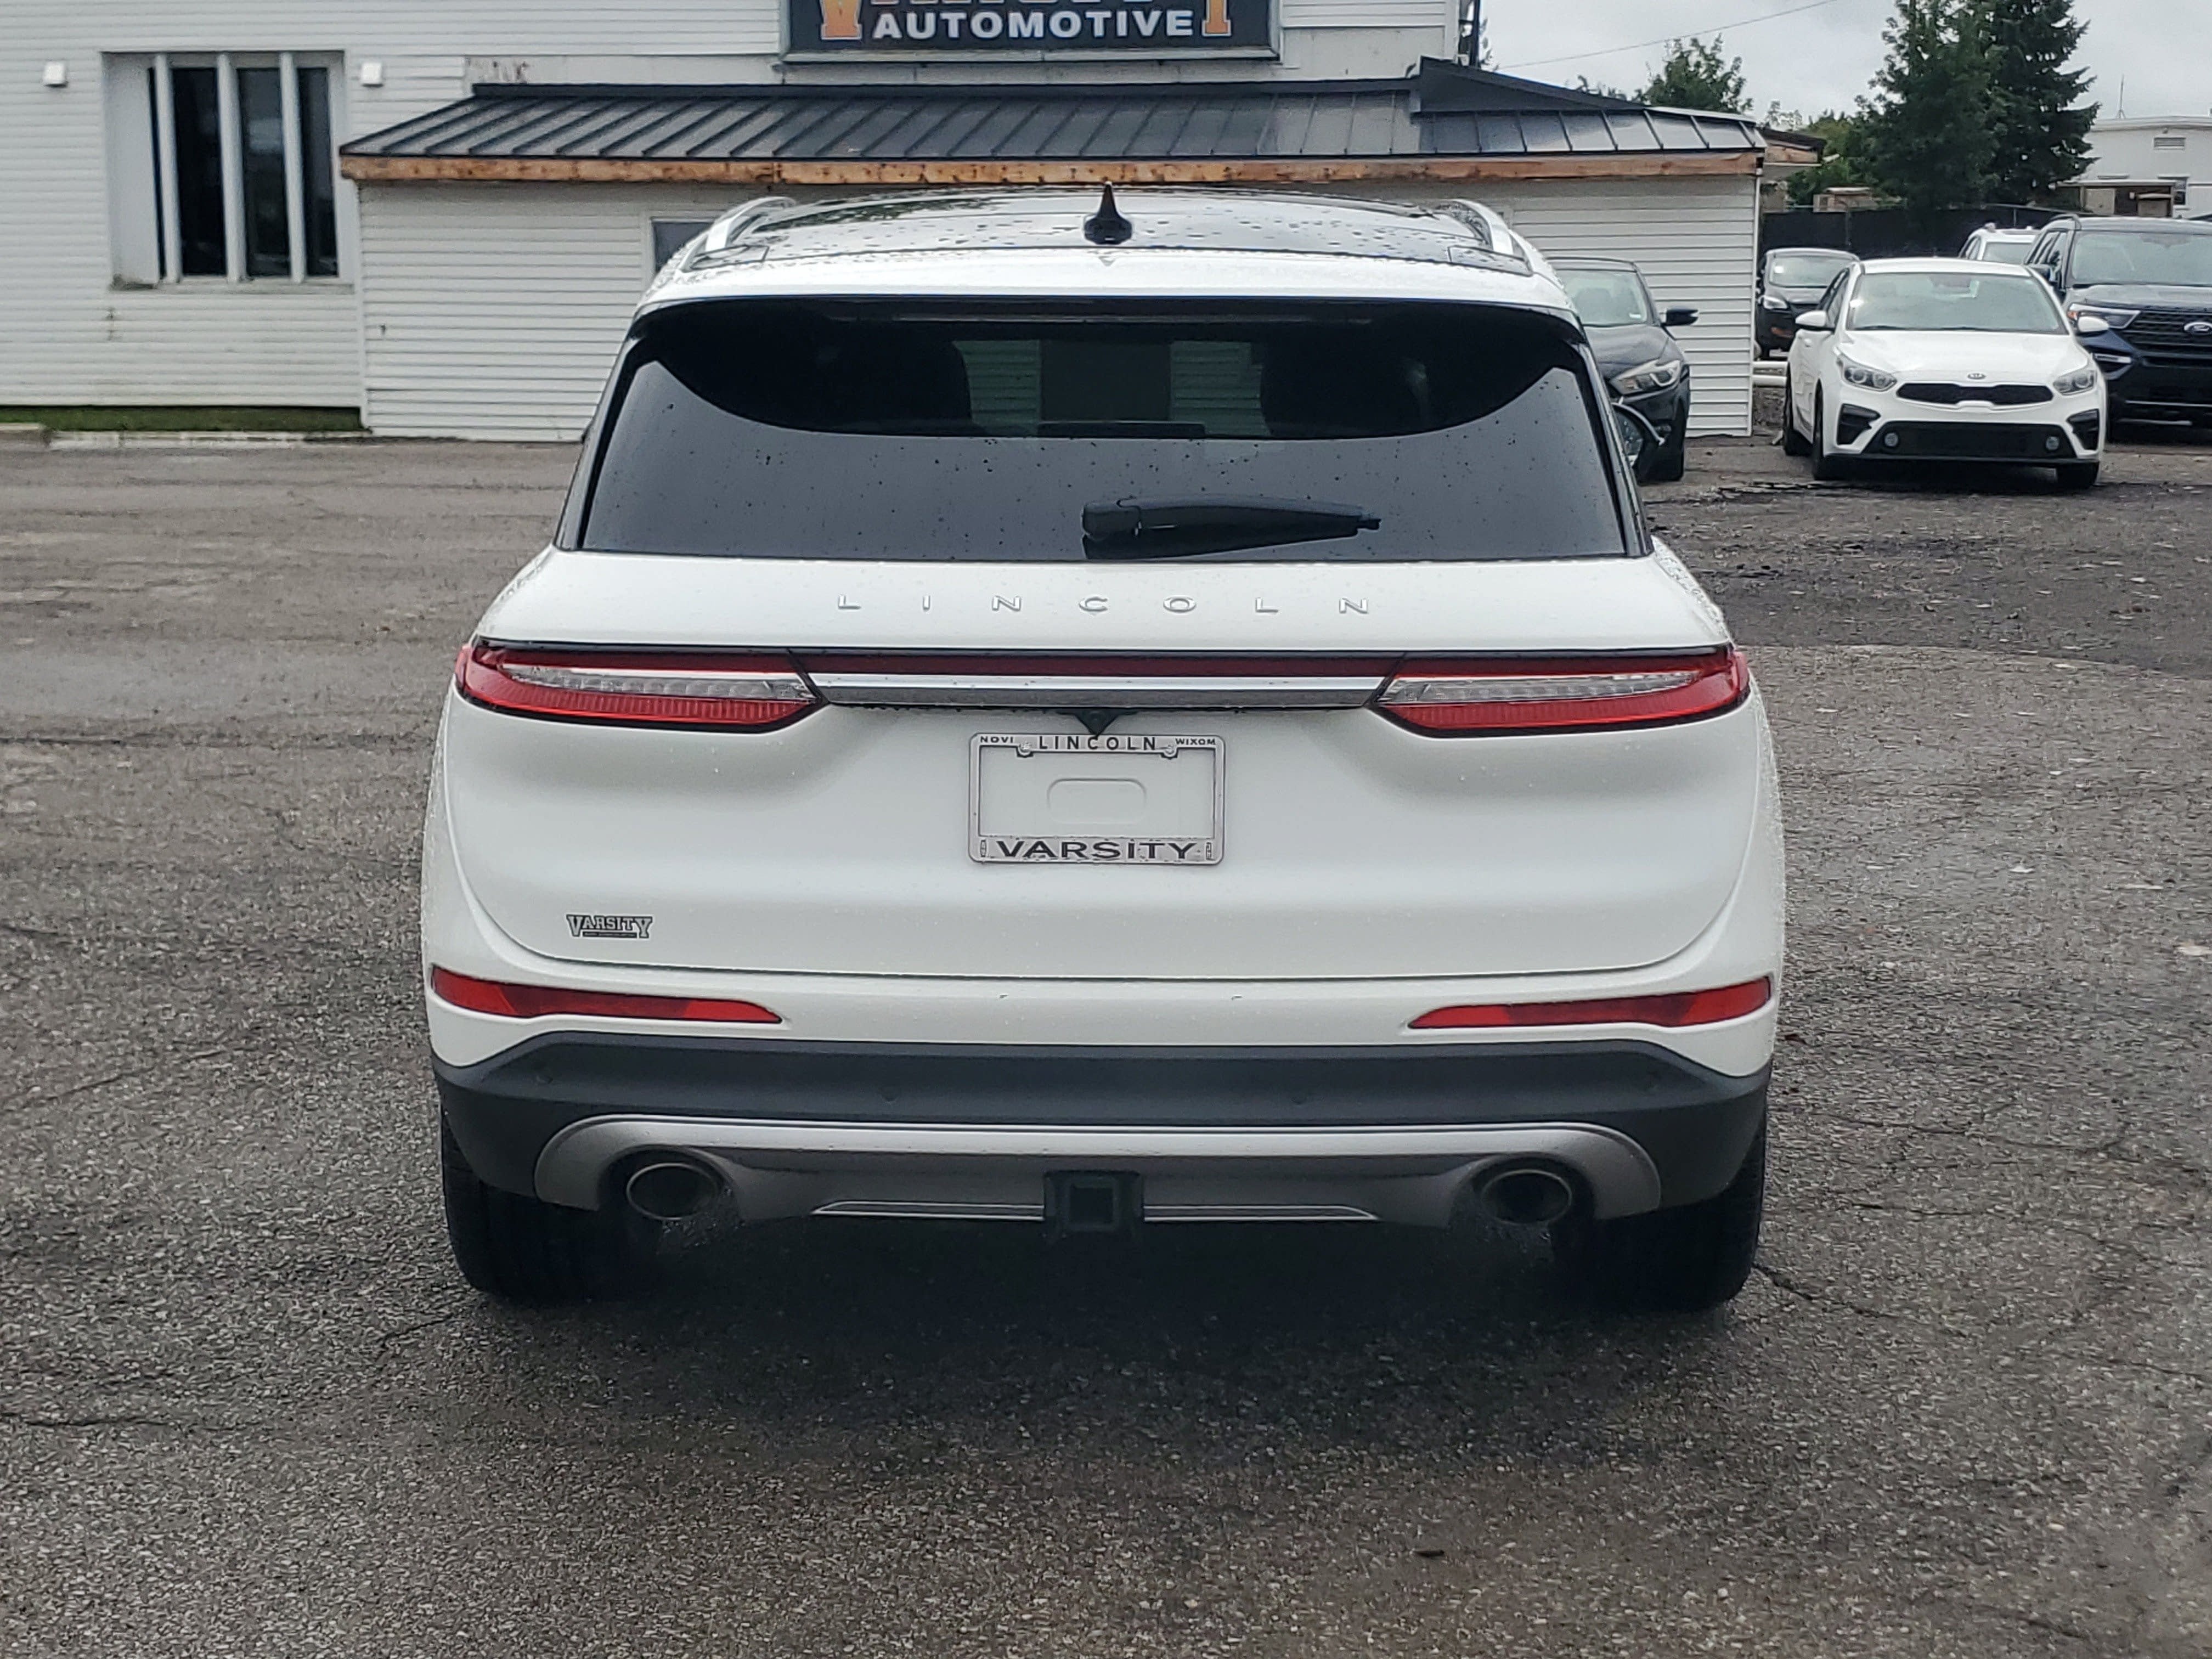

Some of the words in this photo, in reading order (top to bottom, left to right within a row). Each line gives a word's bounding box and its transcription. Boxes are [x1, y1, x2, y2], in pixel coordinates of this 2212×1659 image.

[872, 10, 1194, 40] AUTOMOTIVE
[837, 594, 1368, 614] LINCOLN
[1039, 736, 1156, 751] LINCOLN
[996, 840, 1197, 860] VARSITY
[566, 915, 653, 939] VARSITY
